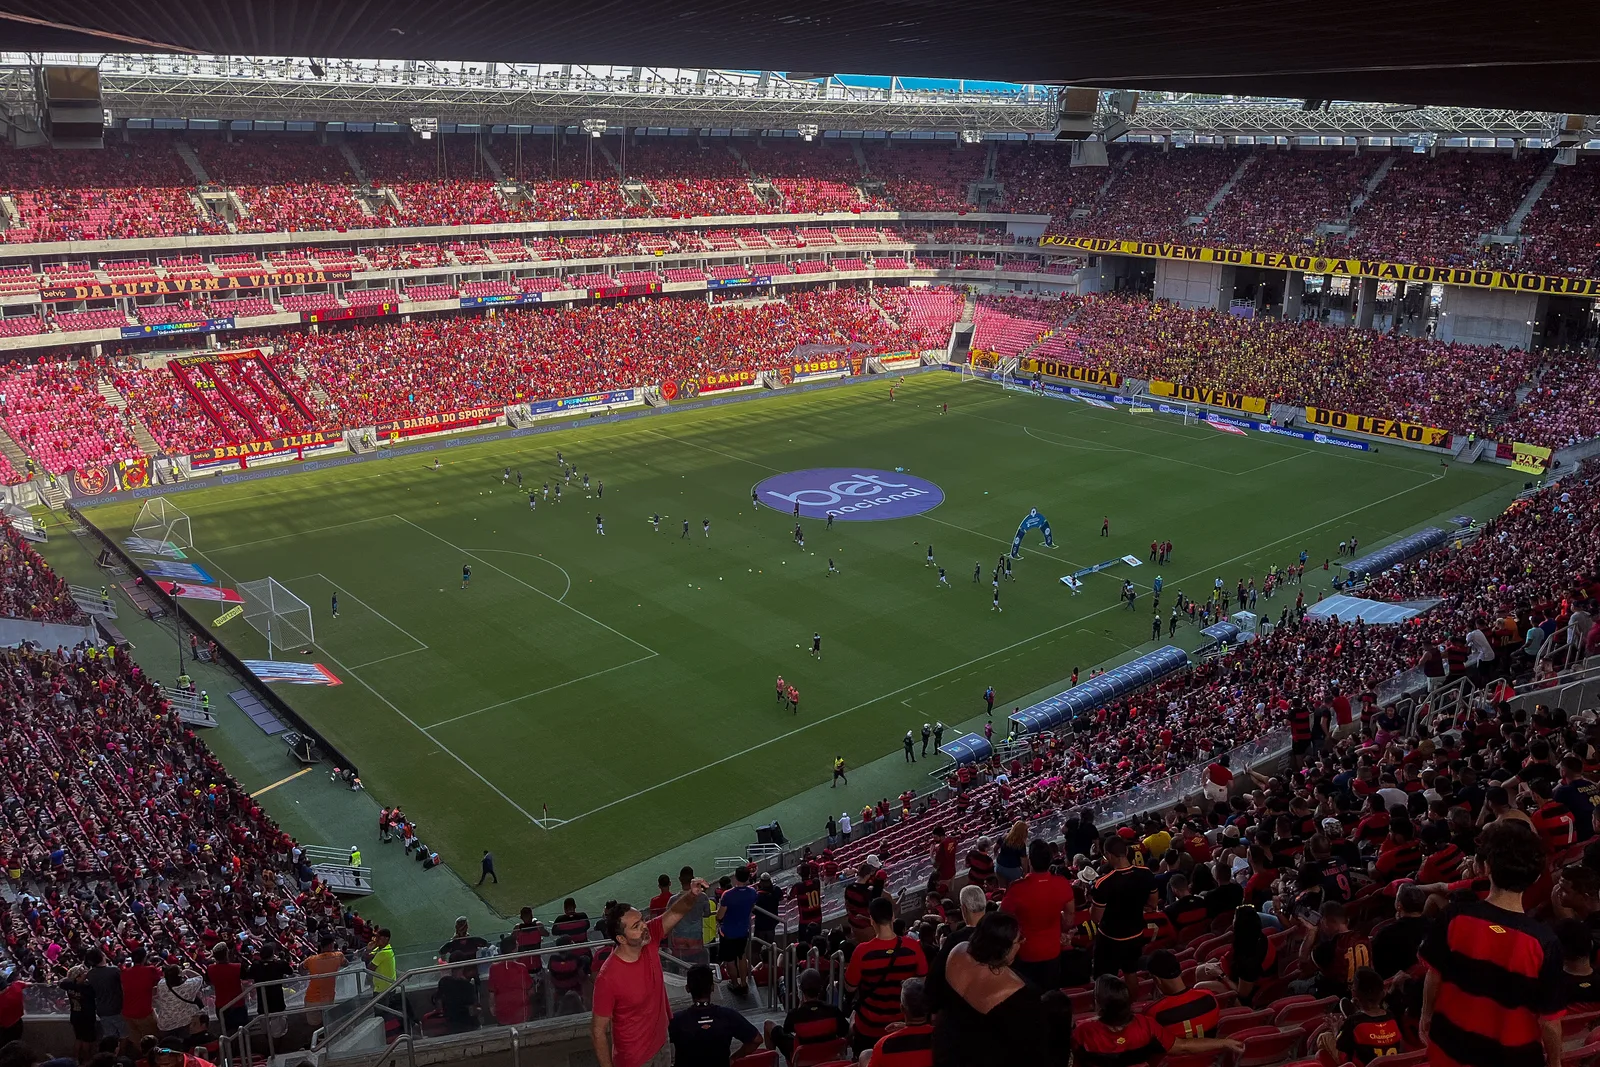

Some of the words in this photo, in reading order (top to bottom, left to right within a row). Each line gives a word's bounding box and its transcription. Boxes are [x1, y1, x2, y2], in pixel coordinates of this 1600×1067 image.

[1041, 235, 1122, 252] TORCIDA
[1132, 242, 1202, 260] JOVEM
[1212, 249, 1242, 264] DO
[1333, 259, 1350, 274] A
[43, 290, 67, 298] betvip
[74, 285, 105, 299] DA
[109, 281, 170, 297] LUTA
[174, 278, 220, 291] VEM
[228, 276, 241, 288] A
[152, 321, 208, 331] PERNAMBUCO
[707, 371, 749, 385] GANG
[564, 393, 610, 406] PERNAMBUCO
[1036, 360, 1112, 385] TORCIDA
[1168, 383, 1244, 409] JOVEM
[1314, 409, 1348, 428] DO
[392, 421, 401, 431] A
[402, 415, 440, 429] BARRA
[441, 413, 456, 423] DO
[458, 407, 491, 420] SPORT
[214, 440, 274, 459] BRAVA
[282, 432, 325, 448] ILHA
[1516, 453, 1544, 466] PAZ
[766, 473, 908, 506] bet
[825, 487, 930, 517] nacional
[215, 606, 242, 625] quartzolit
[1336, 873, 1352, 900] 9
[805, 889, 820, 909] 10
[1344, 943, 1370, 983] 10
